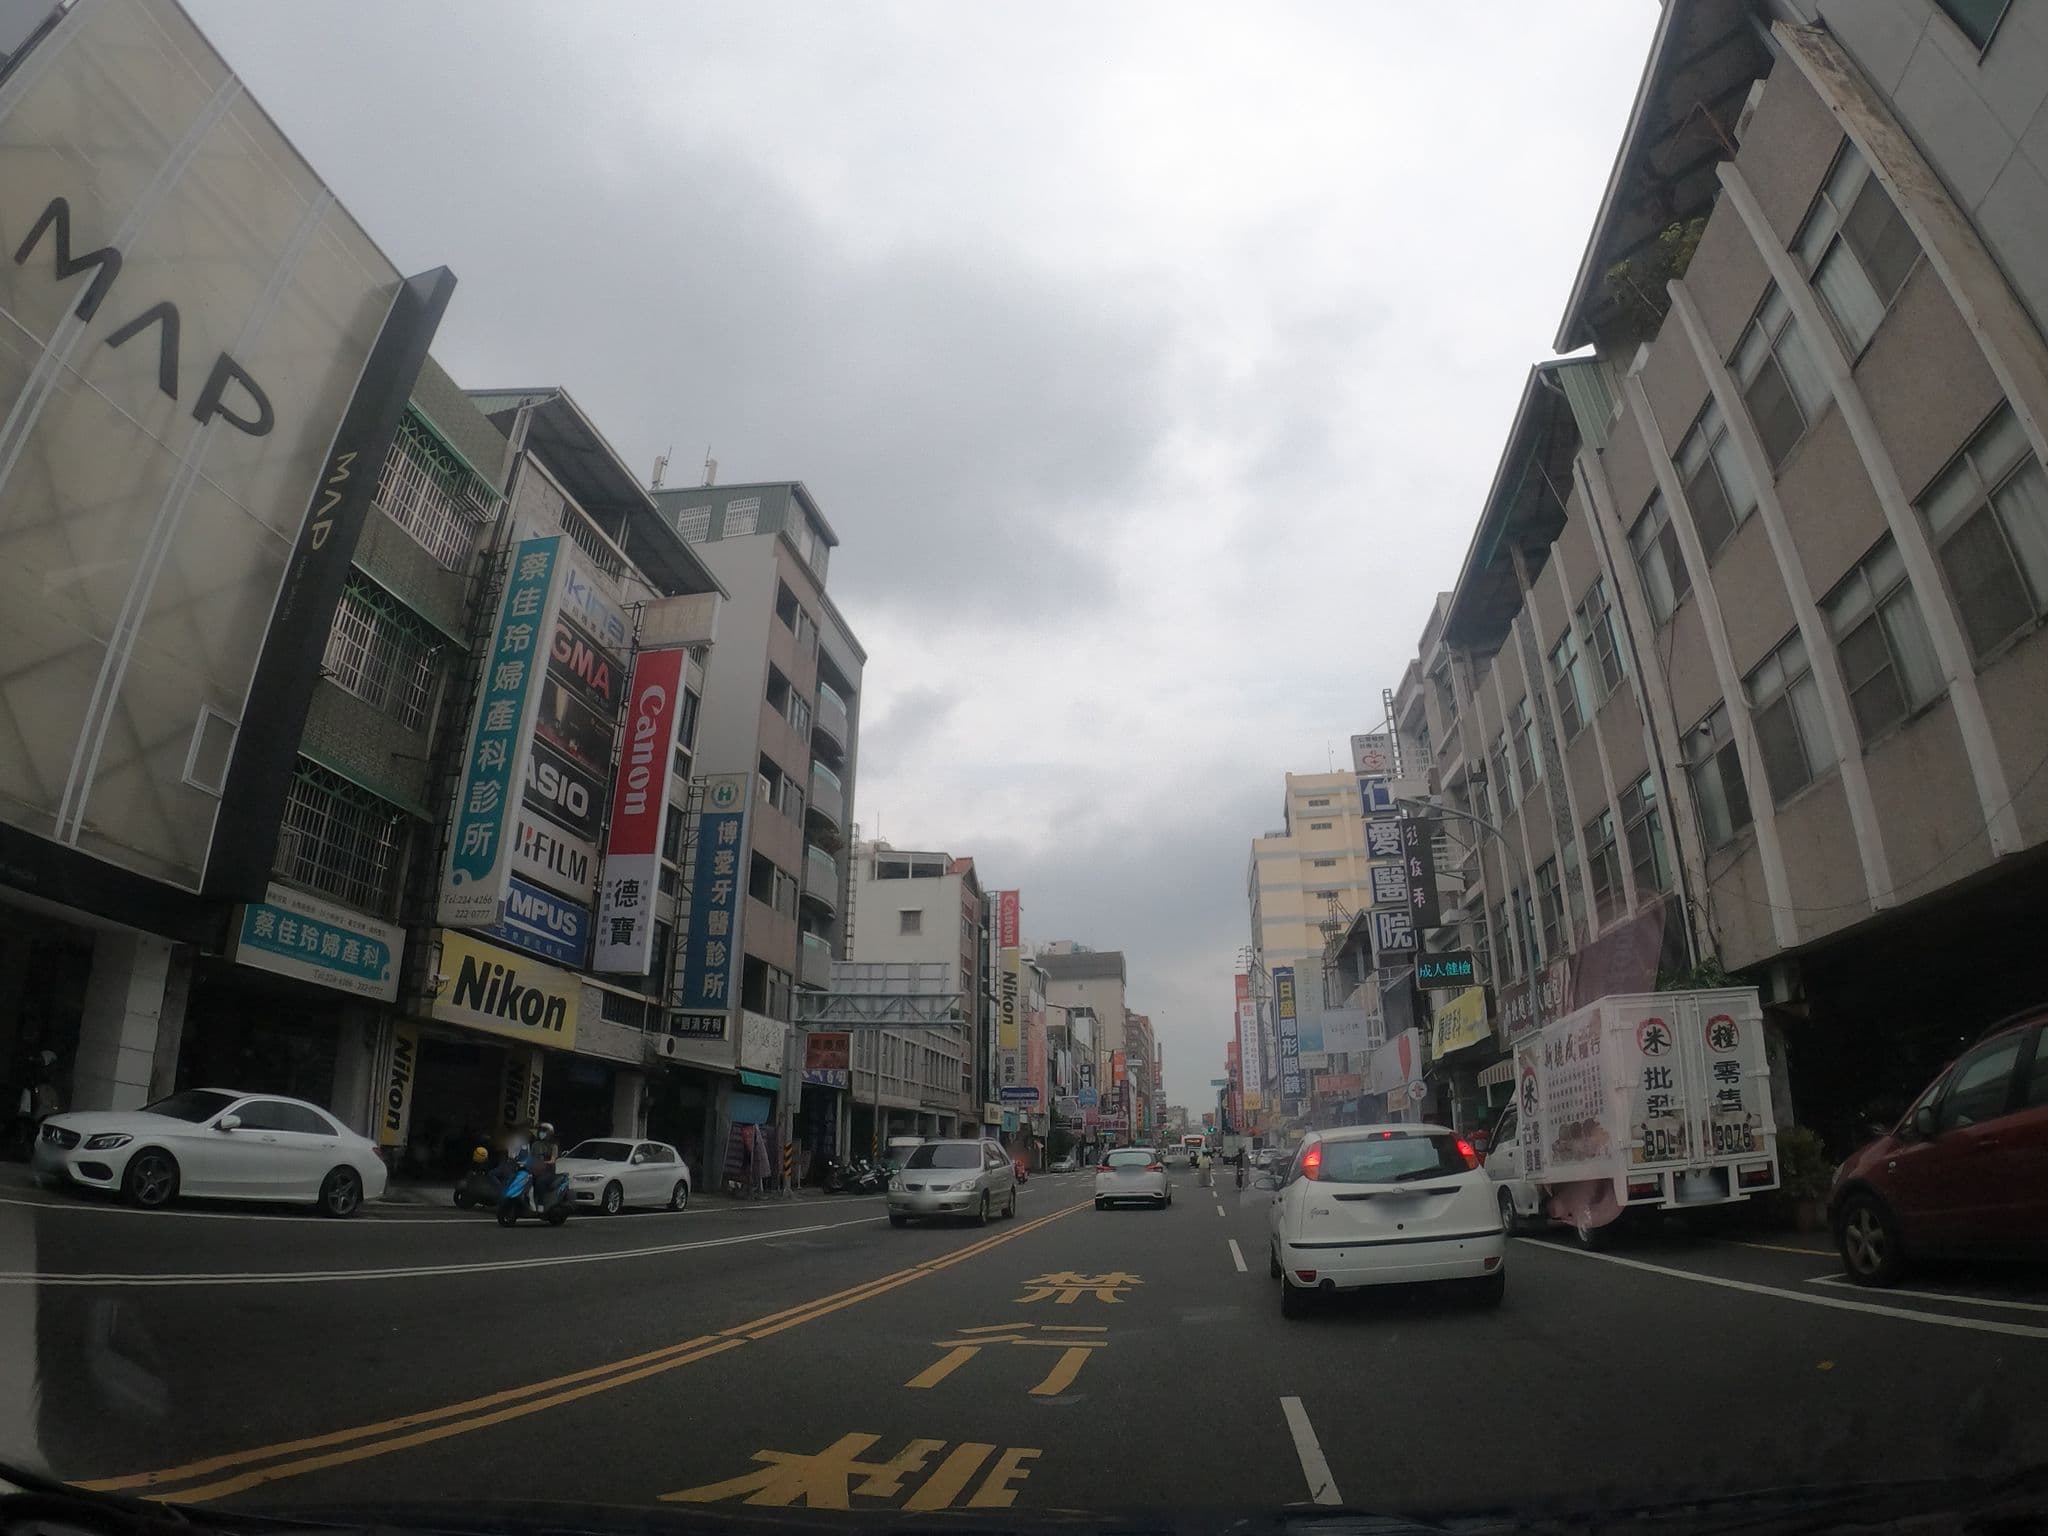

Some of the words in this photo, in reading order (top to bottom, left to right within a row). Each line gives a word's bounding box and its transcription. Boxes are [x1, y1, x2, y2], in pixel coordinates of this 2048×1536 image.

[14, 195, 275, 437] MAP
[311, 450, 358, 551] MAP
[564, 568, 625, 643] kina
[460, 551, 553, 857] 蔡佳玲婦產科診所
[624, 684, 667, 817] Canon
[1363, 780, 1413, 949] 仁愛醫院
[252, 909, 380, 969] 蔡佳玲婦產科
[610, 878, 640, 947] 德寶
[701, 819, 739, 999] 博愛牙醫診所
[451, 954, 569, 1033] Nikon
[1002, 971, 1018, 1026] Nikon
[1419, 960, 1472, 978] 成人健檢
[386, 1035, 414, 1130] Nikon
[1643, 1065, 1675, 1120] 批發
[1713, 1059, 1743, 1113] 零售
